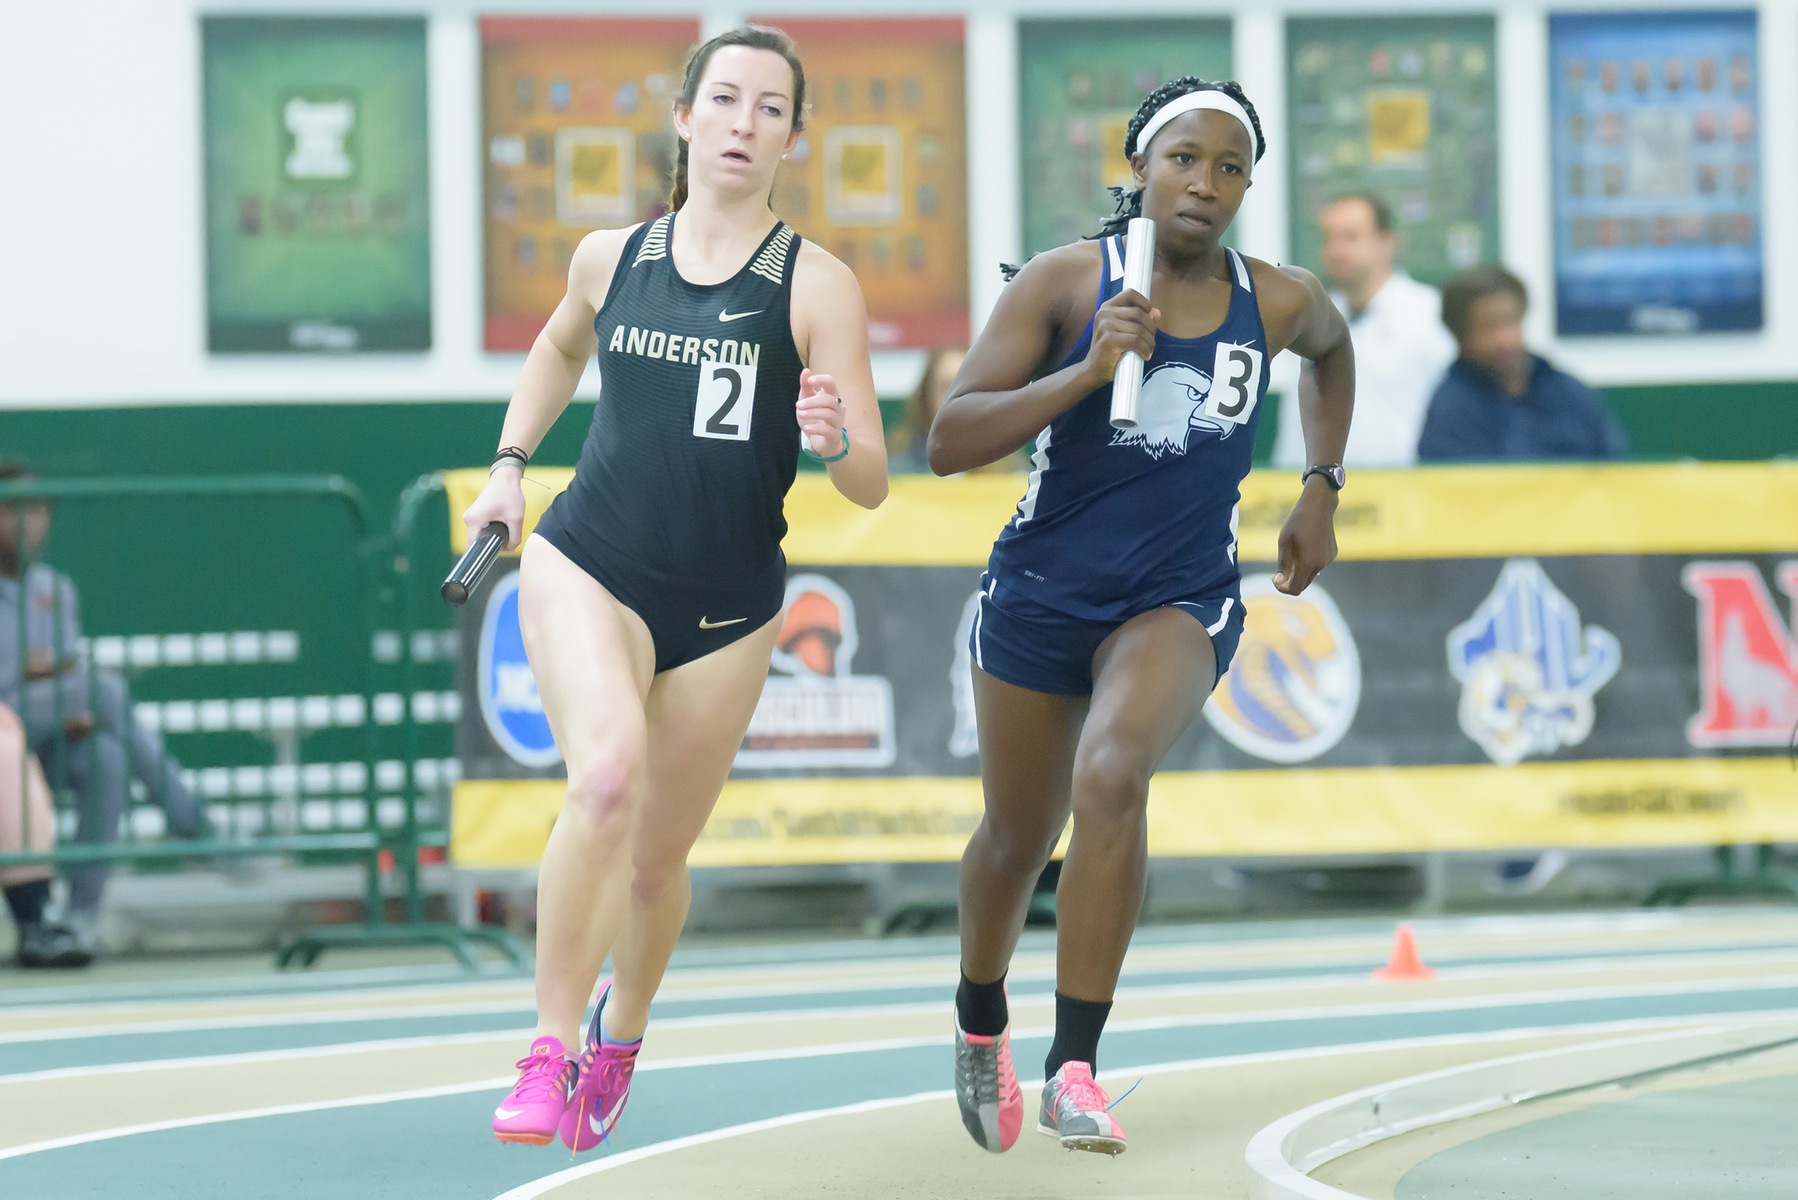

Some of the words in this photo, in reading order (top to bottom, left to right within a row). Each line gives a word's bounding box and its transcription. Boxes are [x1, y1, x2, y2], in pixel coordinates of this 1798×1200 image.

[609, 325, 760, 366] ANDERSON
[706, 368, 742, 435] 2
[1217, 350, 1253, 417] 3
